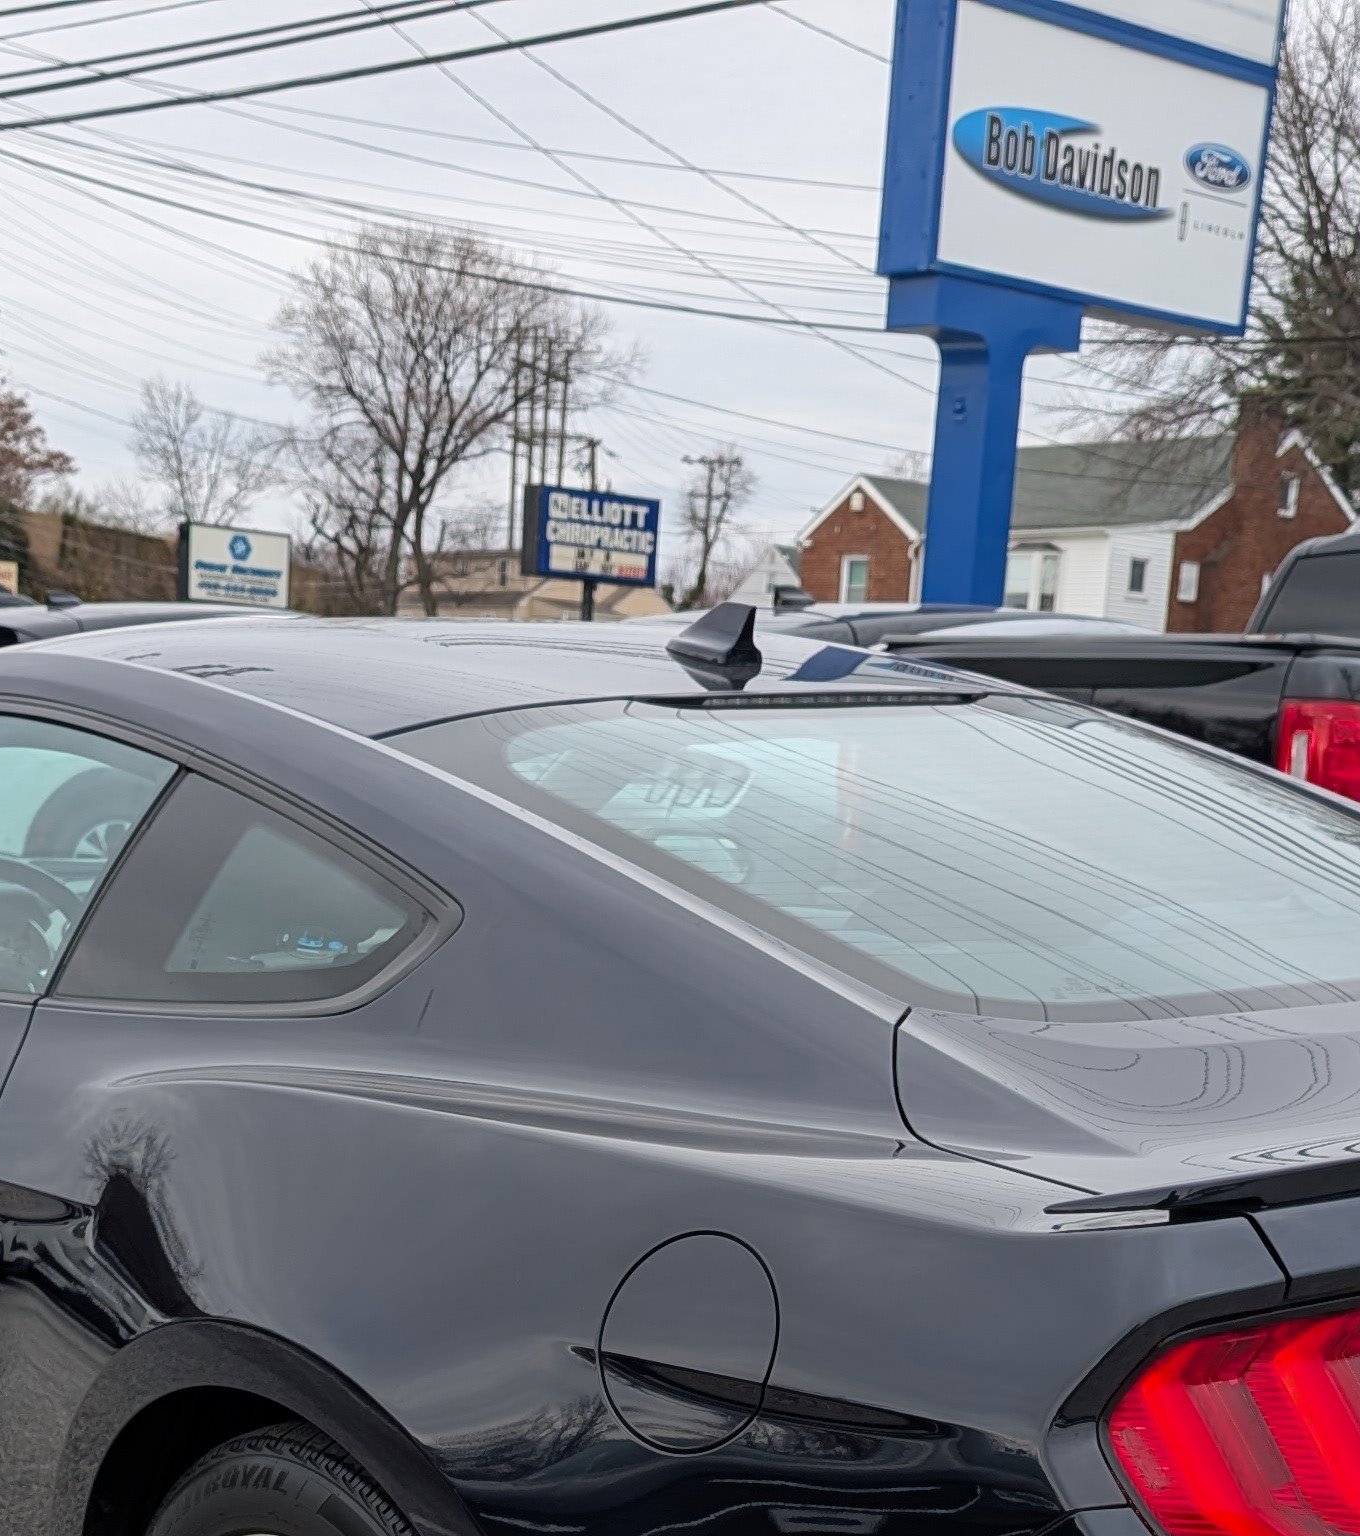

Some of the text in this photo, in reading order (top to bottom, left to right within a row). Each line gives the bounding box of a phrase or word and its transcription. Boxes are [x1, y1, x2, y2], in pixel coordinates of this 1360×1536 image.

[985, 114, 1160, 209] Bob Davidson
[1195, 149, 1243, 187] Ford
[571, 496, 650, 529] ELLIOTT
